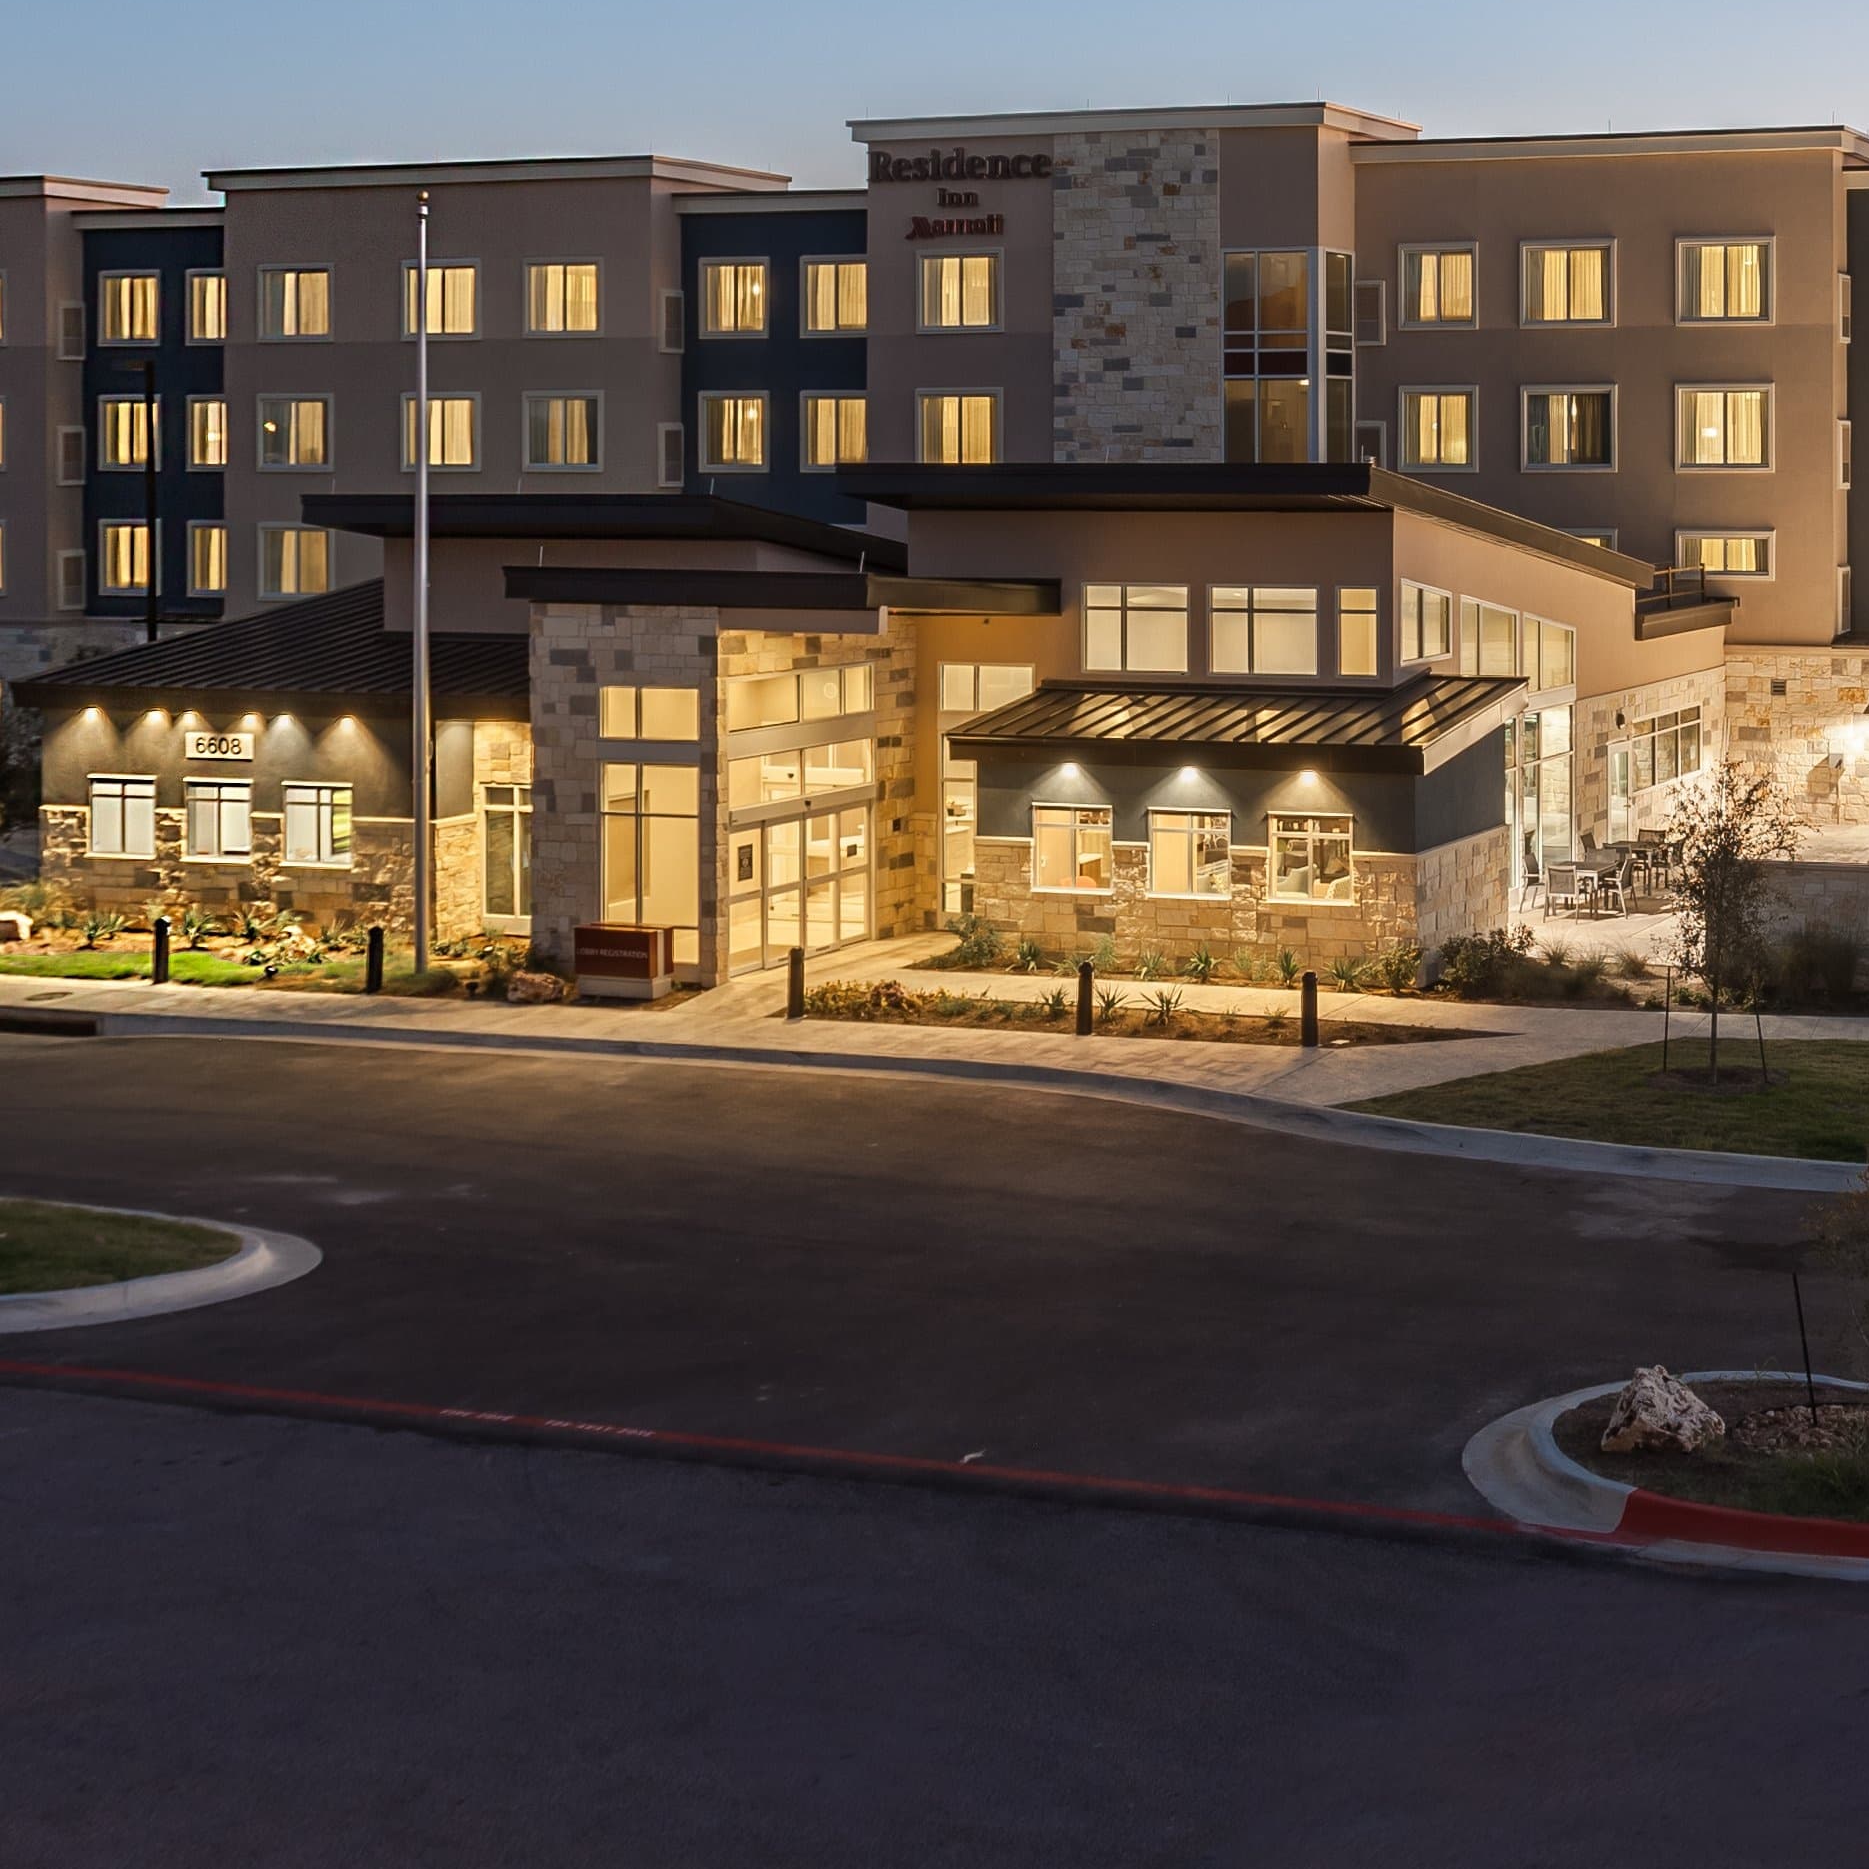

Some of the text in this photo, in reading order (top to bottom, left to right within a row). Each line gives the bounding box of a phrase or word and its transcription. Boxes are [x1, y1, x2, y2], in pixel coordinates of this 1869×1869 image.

[869, 147, 1052, 182] Residence
[937, 188, 980, 208] Inn
[905, 214, 1004, 240] Marriott
[195, 737, 242, 755] 6608
